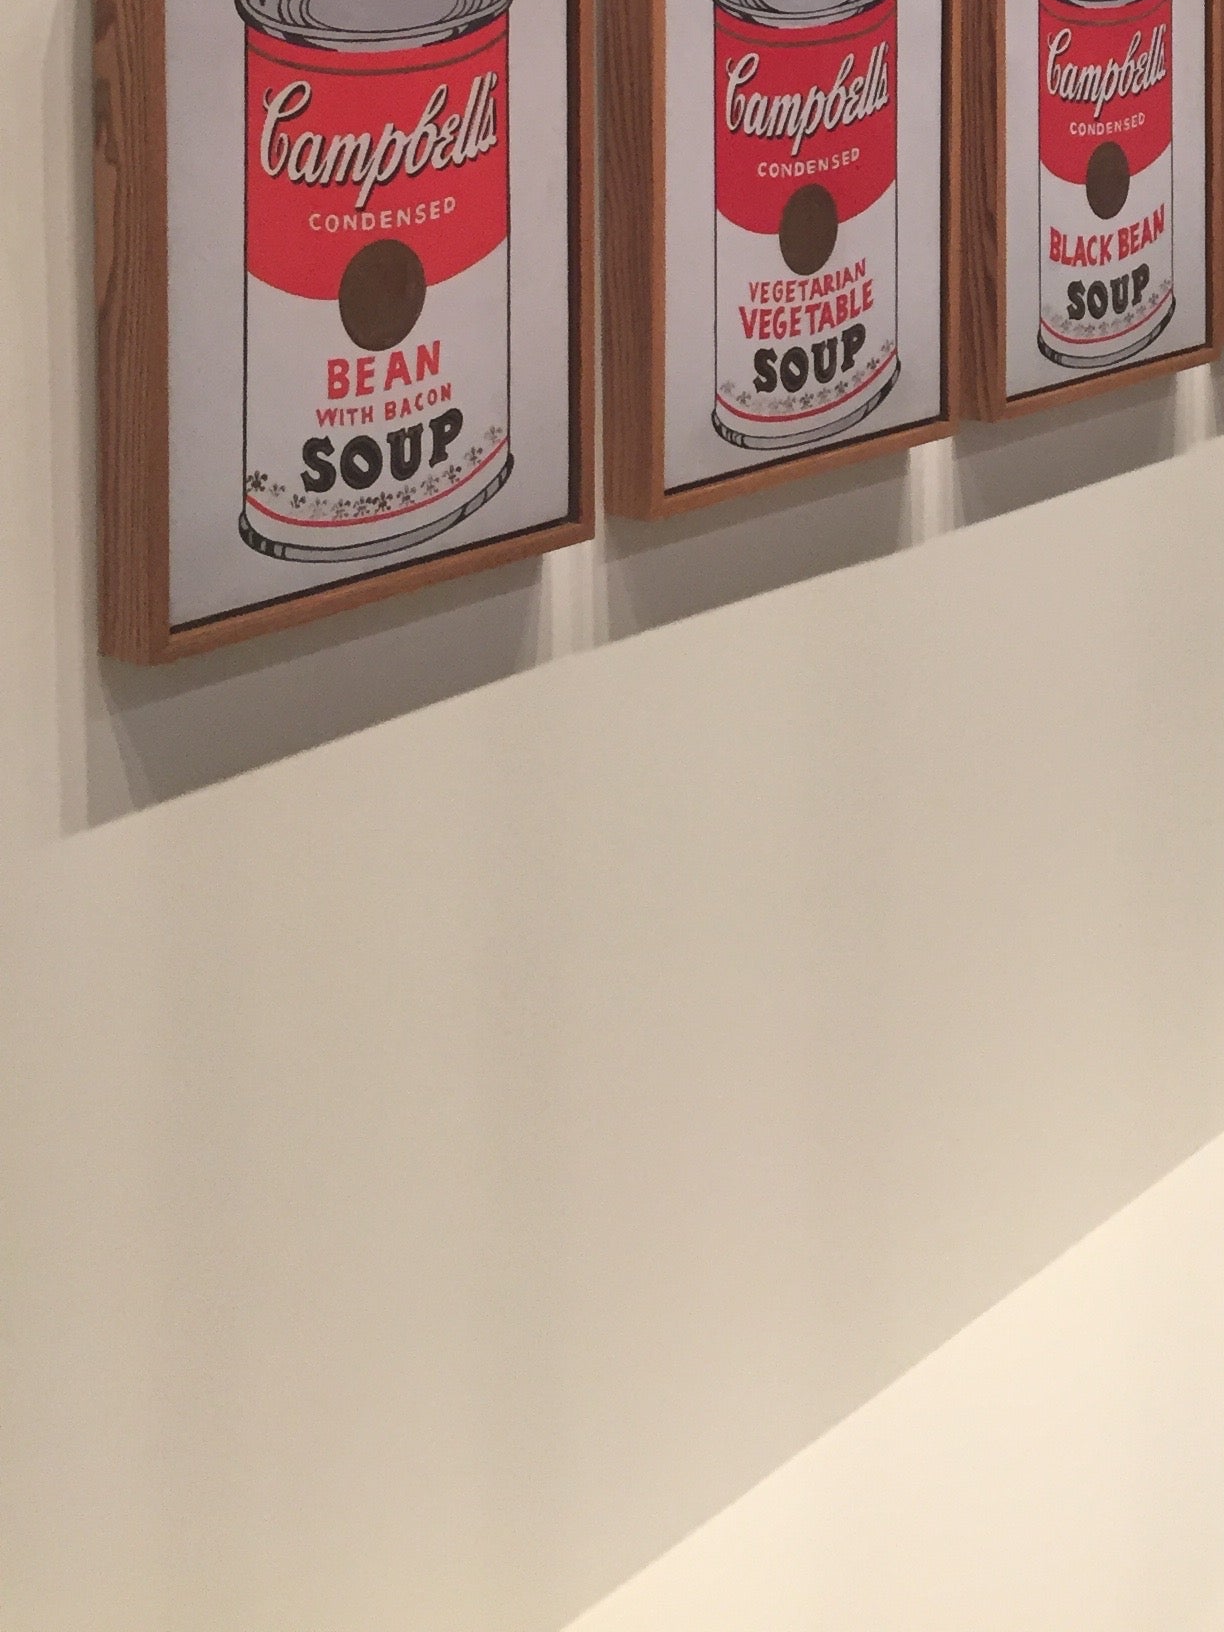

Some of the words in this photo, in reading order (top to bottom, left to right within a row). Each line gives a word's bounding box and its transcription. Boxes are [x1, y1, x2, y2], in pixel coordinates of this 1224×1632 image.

[725, 40, 889, 157] Campbell's
[1047, 23, 1167, 118] Campbell's
[260, 71, 498, 209] Campbell's
[1069, 112, 1145, 136] CONDENSED
[757, 147, 860, 178] CONDENSED
[309, 196, 457, 232] CONDENSED
[1049, 226, 1114, 268] BLACK
[1118, 203, 1165, 259] BEAN
[739, 278, 874, 341] VEGETABLE
[748, 258, 867, 304] VEGETARIAN
[1067, 263, 1150, 320] SOUP
[327, 340, 441, 400] BEAN
[753, 323, 867, 394] SOUP
[315, 407, 374, 428] WITH
[384, 383, 452, 421] BACON
[300, 407, 463, 494] SOUP
